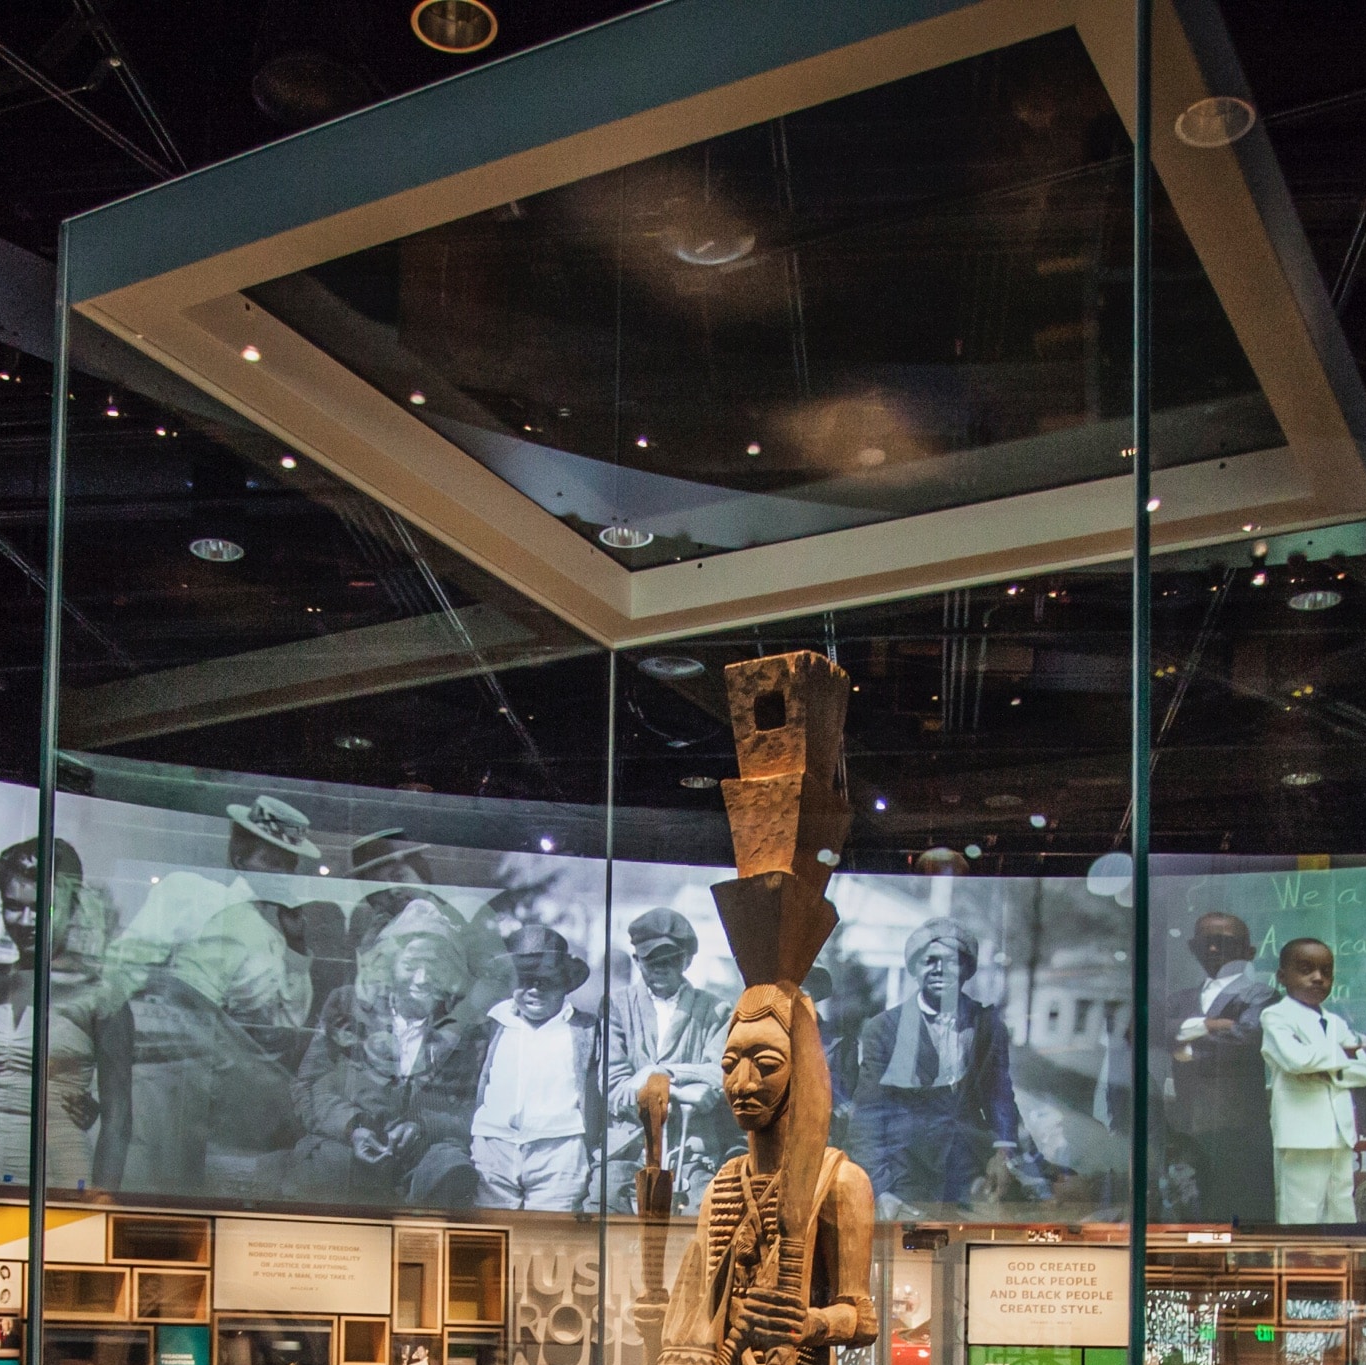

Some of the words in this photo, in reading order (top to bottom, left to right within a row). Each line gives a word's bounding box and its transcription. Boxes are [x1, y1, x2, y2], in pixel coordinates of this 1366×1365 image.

[1272, 874, 1325, 909] We
[248, 1241, 277, 1249] NOBODY
[279, 1242, 293, 1250] CAN
[328, 1244, 362, 1252] FREEDOM.
[329, 1254, 361, 1262] EQUALITY
[1007, 1261, 1035, 1271] GOD
[1039, 1262, 1096, 1272] CREATED
[1005, 1276, 1045, 1286] BLACK
[1050, 1276, 1098, 1286] PEOPLE
[990, 1290, 1017, 1299] AND
[1021, 1290, 1061, 1300] BLACK
[1066, 1291, 1114, 1301] PEOPLE
[1000, 1304, 1056, 1314] CREATED
[1061, 1304, 1103, 1315] STYLE.
